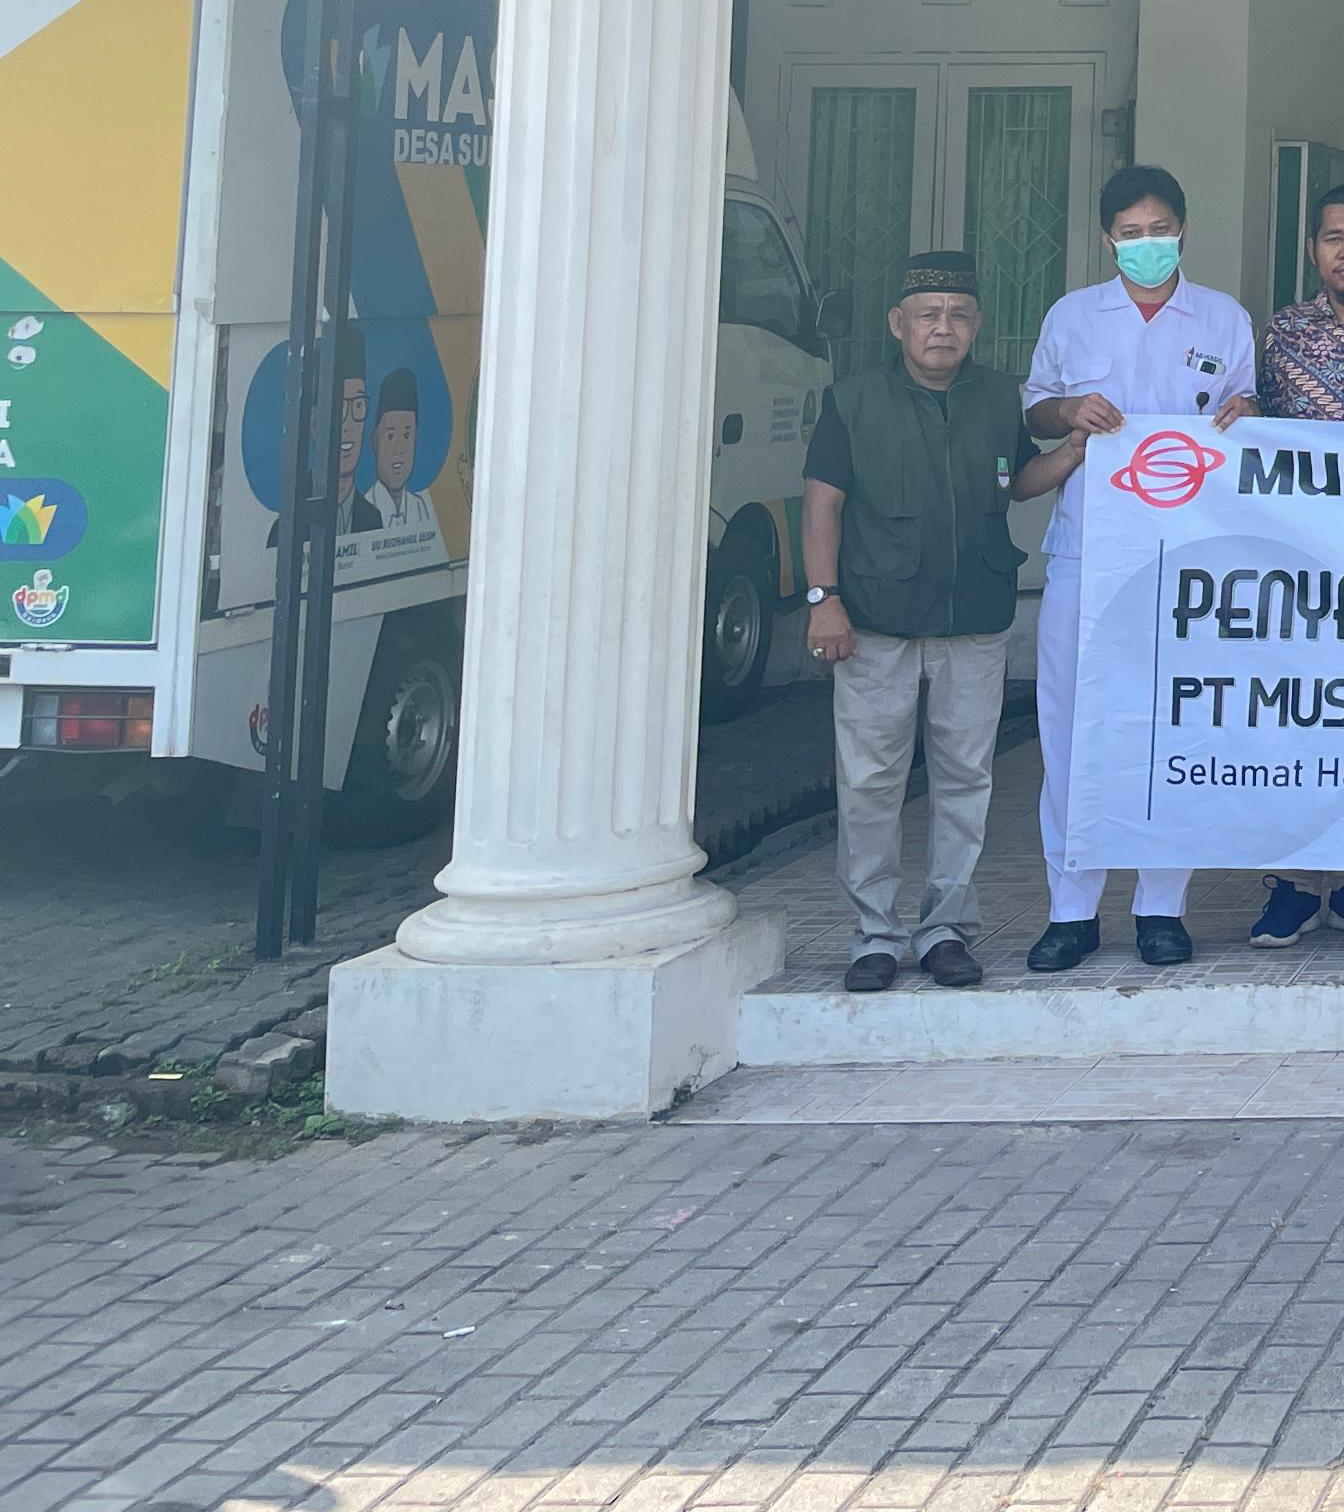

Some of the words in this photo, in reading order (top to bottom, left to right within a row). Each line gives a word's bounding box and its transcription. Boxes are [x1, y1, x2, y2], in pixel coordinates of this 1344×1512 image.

[394, 128, 455, 165] DESA
[458, 133, 493, 167] SU
[1171, 676, 1236, 728] PT
[1166, 755, 1304, 787] Selamat
